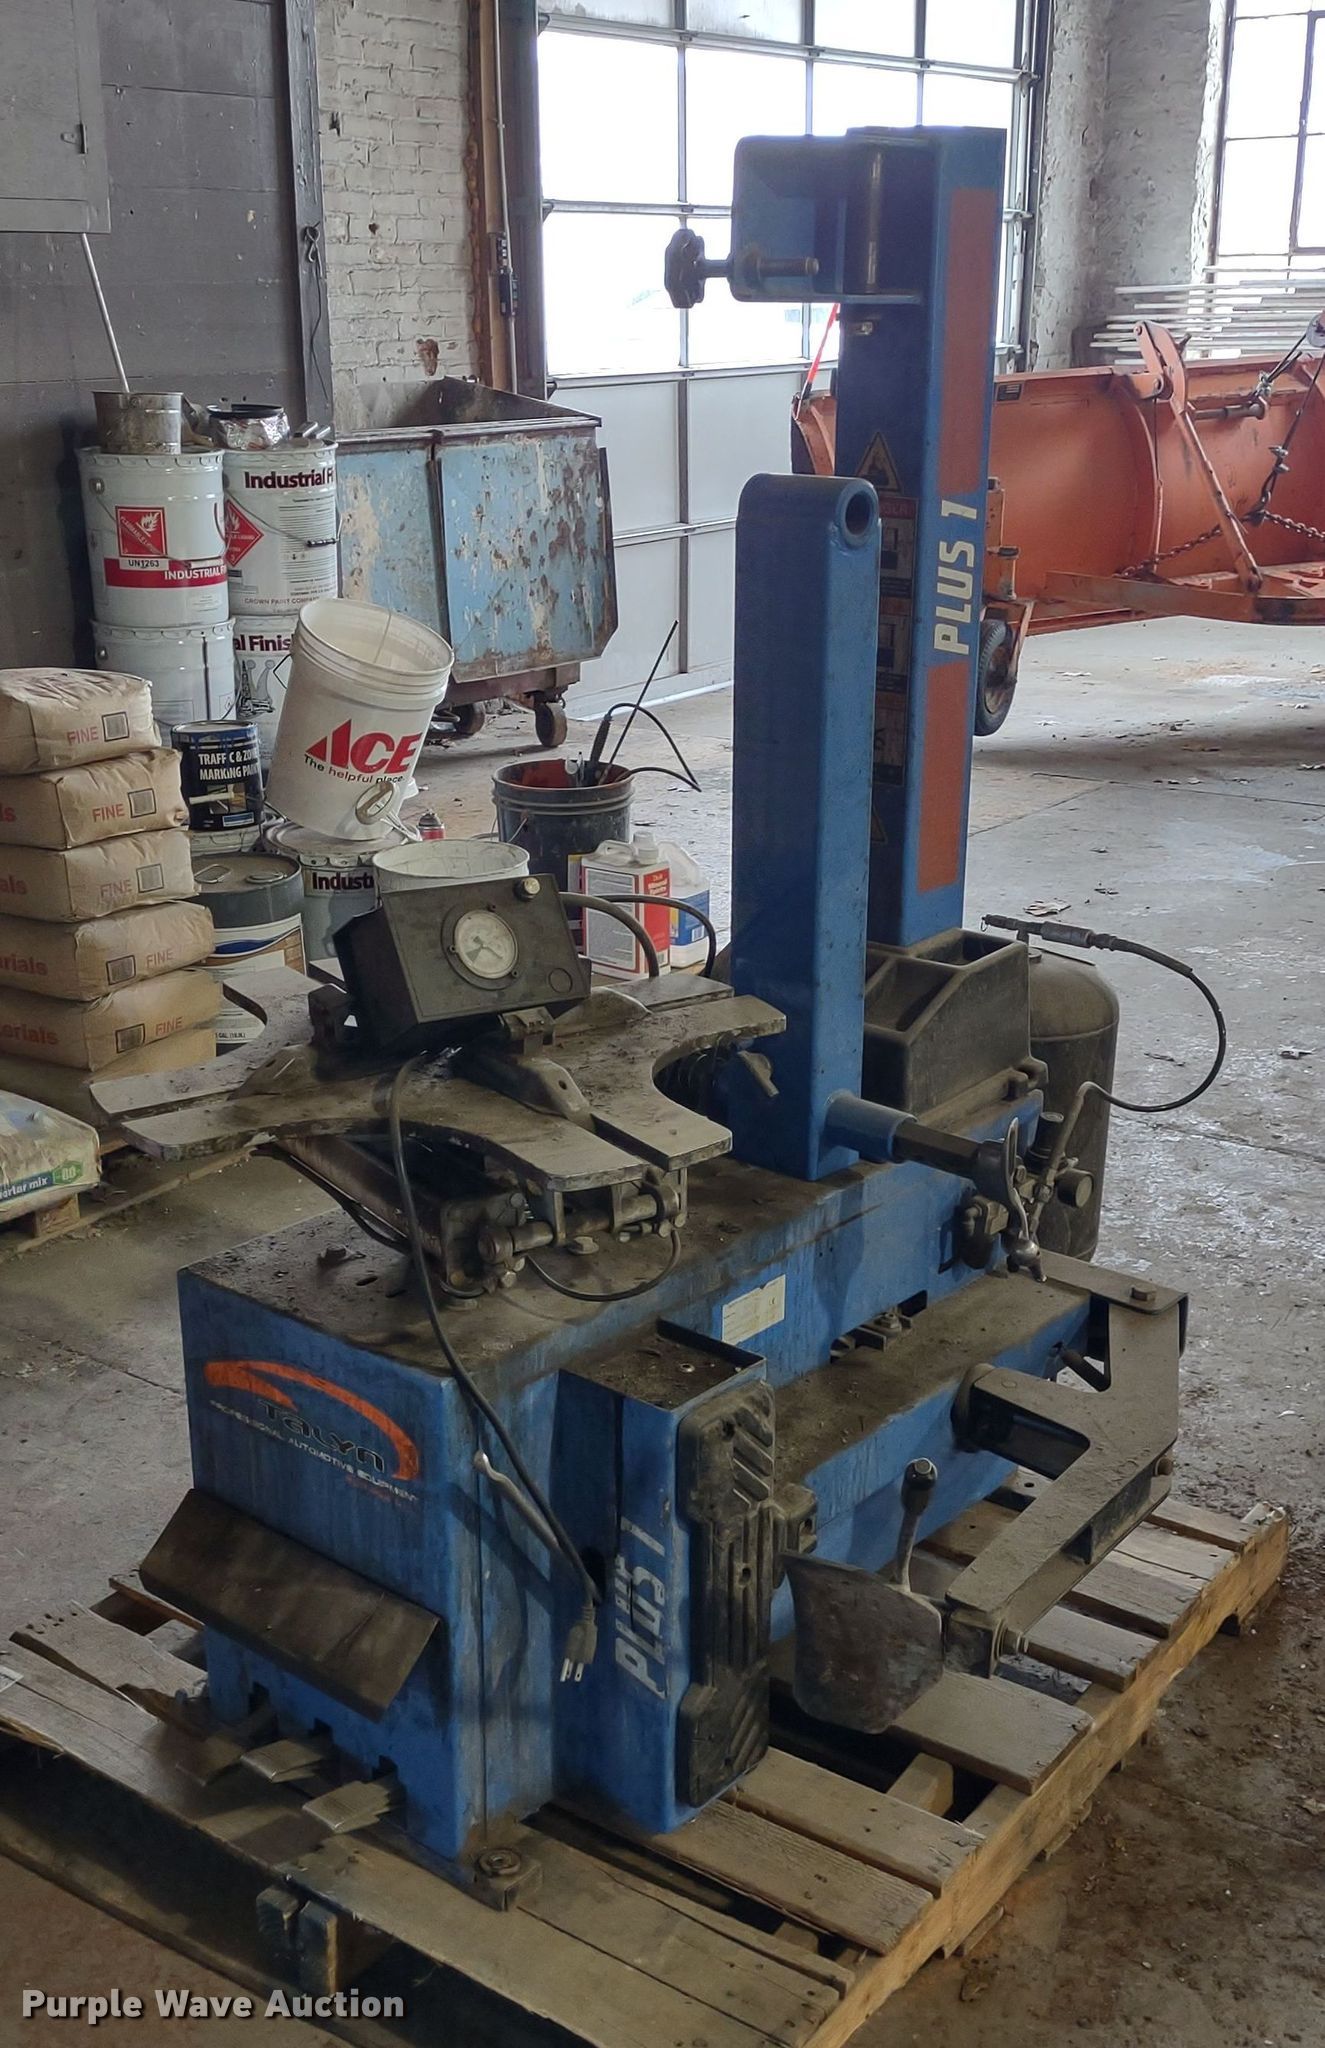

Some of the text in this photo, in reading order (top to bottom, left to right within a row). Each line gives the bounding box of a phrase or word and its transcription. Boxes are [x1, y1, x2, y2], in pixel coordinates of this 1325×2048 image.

[245, 468, 325, 488] Industrial
[164, 568, 220, 580] INDUSTRIAL
[933, 500, 978, 655] PLUS 1
[249, 634, 295, 651] Finis
[67, 727, 99, 745] FINE
[305, 718, 423, 774] ACE
[198, 751, 235, 766] TRAFFC
[200, 766, 242, 781] MARKING
[304, 754, 325, 772] The
[328, 766, 373, 784] helpful
[92, 803, 125, 823] FINE
[101, 880, 133, 899] FINE
[146, 950, 174, 969] FINE
[156, 1016, 183, 1036] FINE
[29, 1176, 48, 1189] mix
[615, 1554, 667, 1700] PLUS
